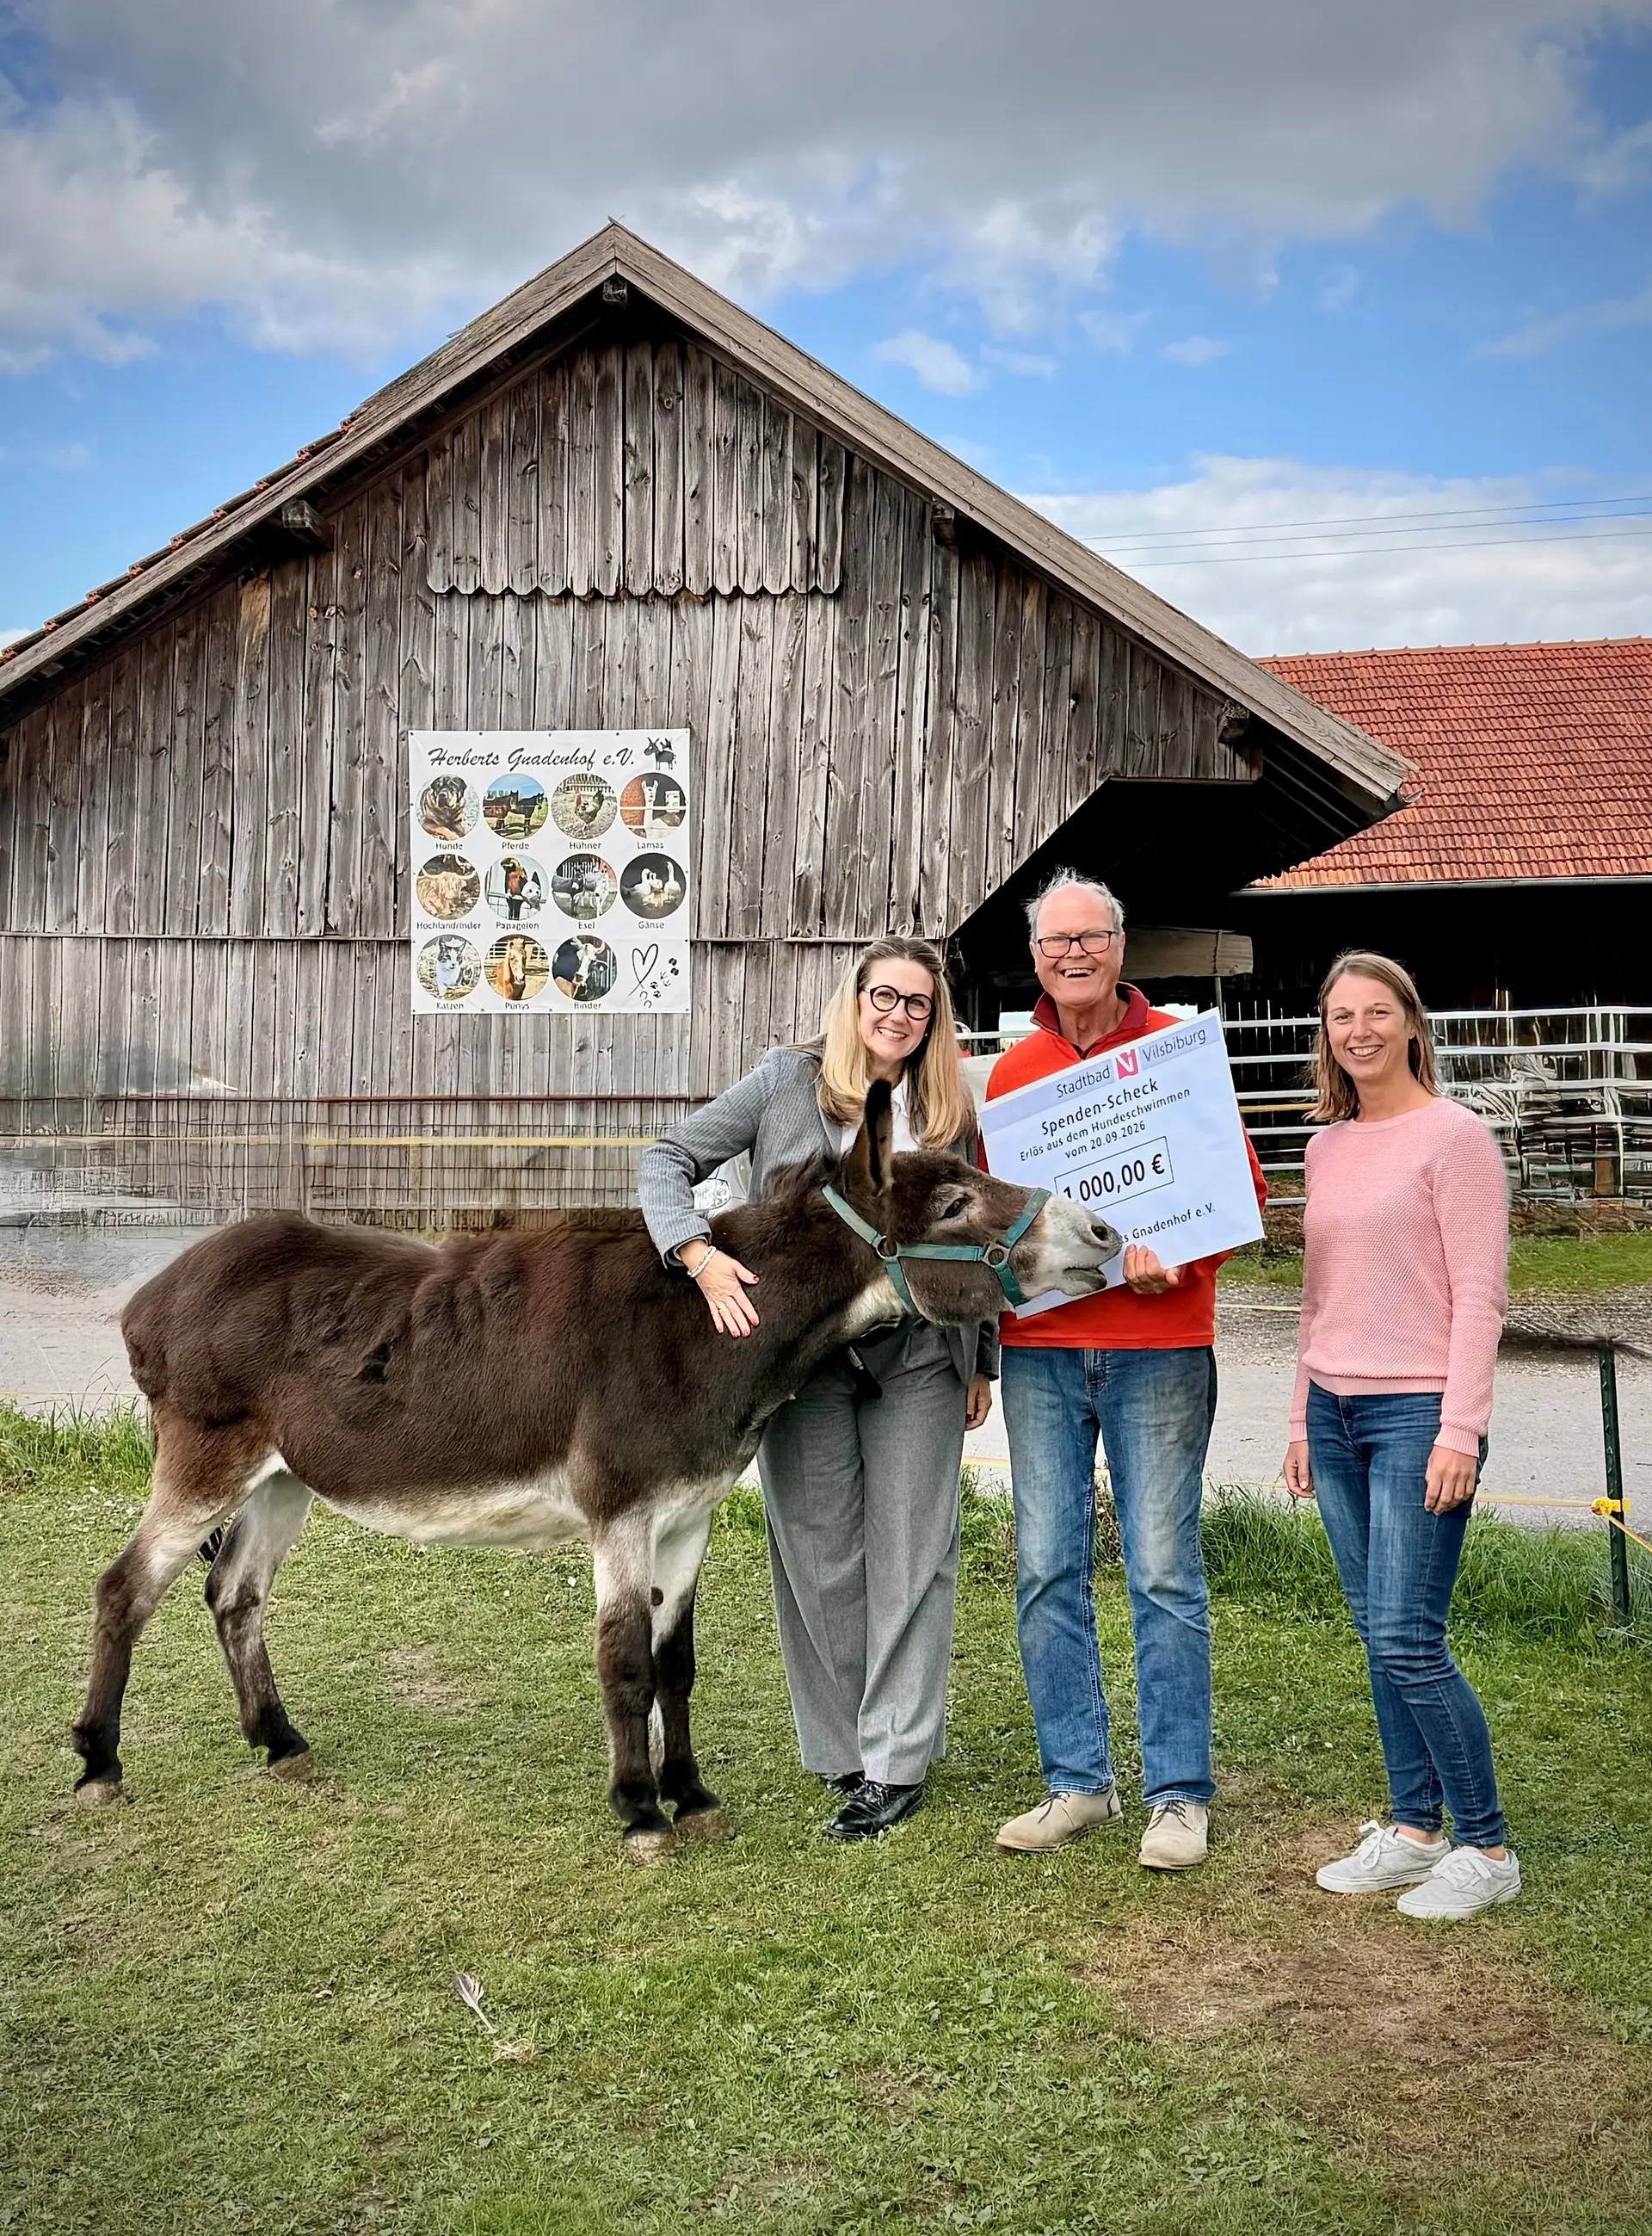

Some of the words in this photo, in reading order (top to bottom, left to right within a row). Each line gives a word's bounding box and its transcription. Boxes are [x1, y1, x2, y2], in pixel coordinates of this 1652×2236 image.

[428, 747, 500, 766] Herberts
[507, 747, 596, 772] Gnadenhof
[602, 747, 634, 767] e.V.
[435, 842, 463, 850] Hunde
[502, 841, 530, 850] Pferde
[569, 841, 602, 849] Hühner
[637, 841, 664, 849] Lamas
[578, 921, 595, 930] Esel
[638, 920, 665, 930] Gänse
[436, 1002, 464, 1010] Katzen
[574, 1000, 601, 1010] Rinder
[1056, 1065, 1111, 1098] Stadtbad
[1142, 1028, 1206, 1062] Vilsbiburg
[1041, 1078, 1159, 1136] Spenden-Scheck
[1020, 1146, 1045, 1162] Erlös
[1046, 1137, 1064, 1152] aus
[1066, 1128, 1089, 1143] dem
[1091, 1088, 1191, 1133] Hundeschwimmen
[1064, 1145, 1088, 1159] vom
[1090, 1120, 1146, 1151] 20.09.2026
[1150, 1152, 1166, 1175] €
[1131, 1208, 1192, 1239] Gnadenhof
[1194, 1201, 1217, 1218] e.V.
